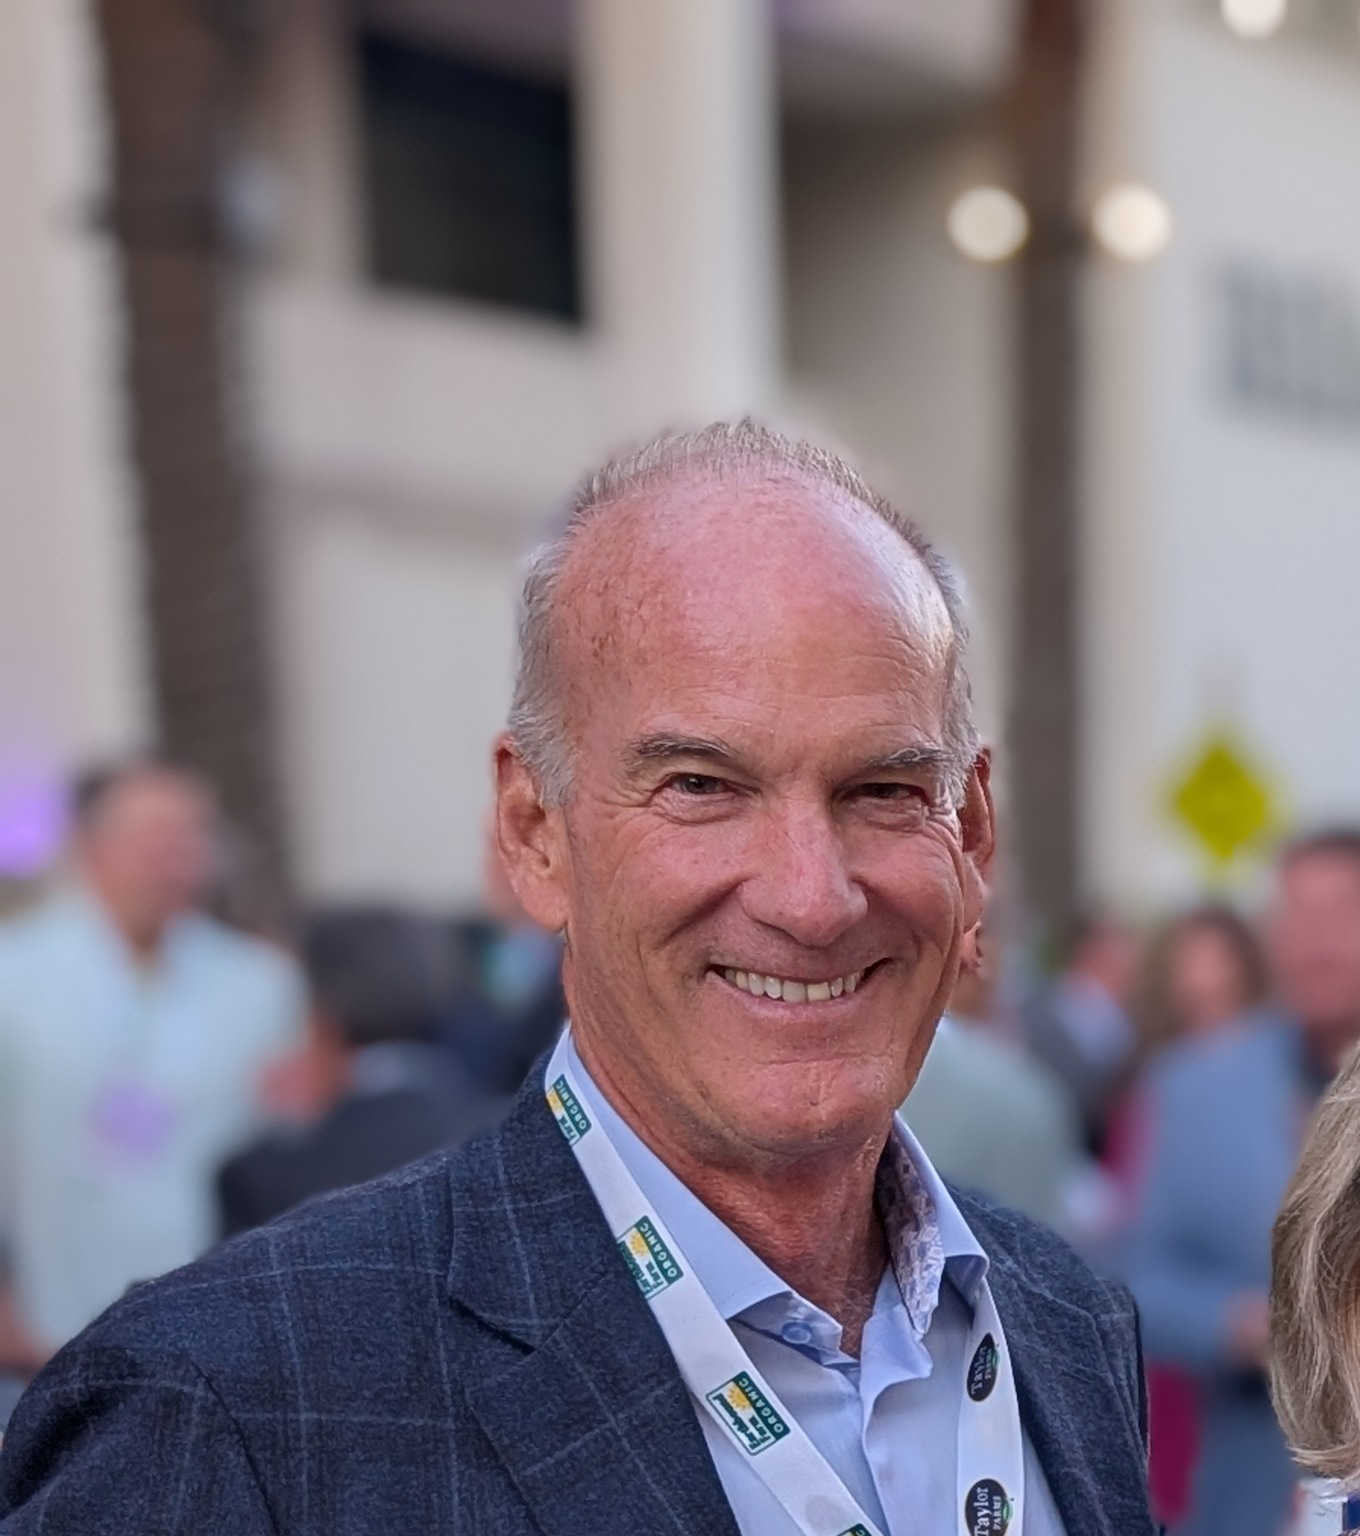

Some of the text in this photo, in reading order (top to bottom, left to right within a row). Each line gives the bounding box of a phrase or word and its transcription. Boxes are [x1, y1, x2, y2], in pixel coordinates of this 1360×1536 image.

[556, 1081, 587, 1130] ORGANIC
[640, 1222, 678, 1278] ORGANIC
[739, 1378, 784, 1433] ORGANIC
